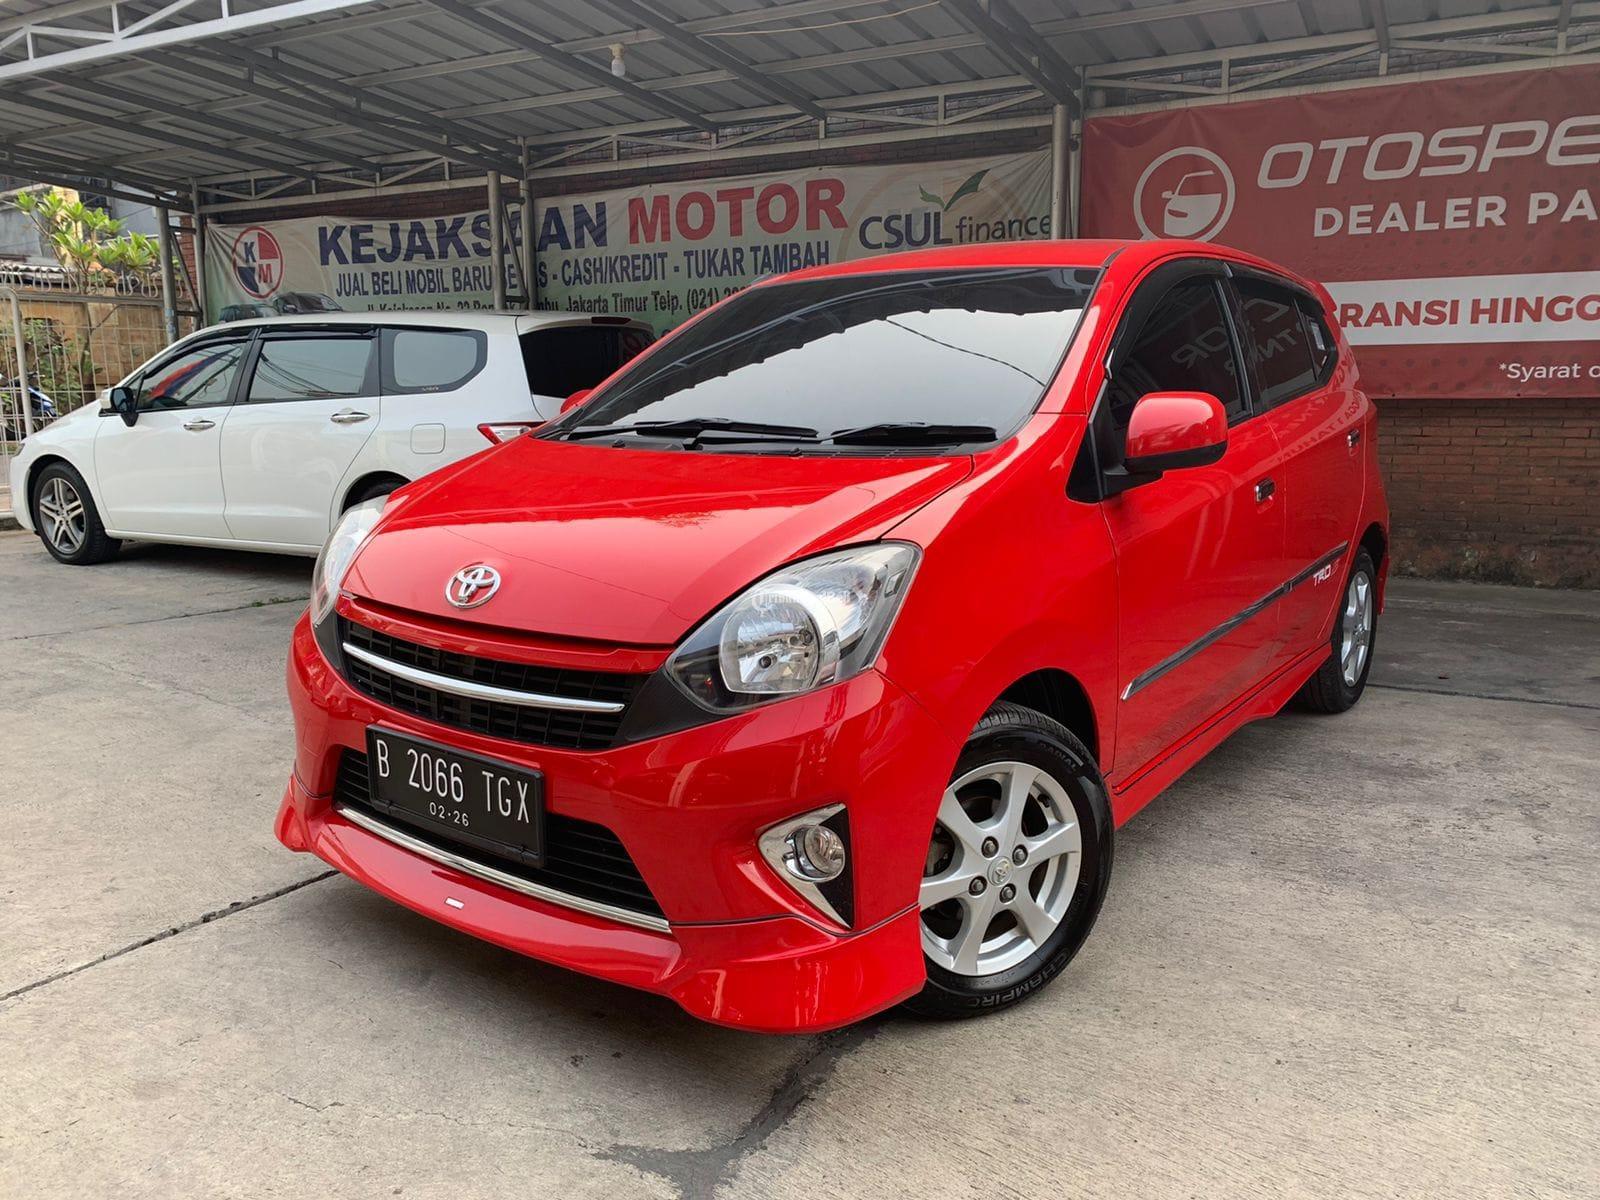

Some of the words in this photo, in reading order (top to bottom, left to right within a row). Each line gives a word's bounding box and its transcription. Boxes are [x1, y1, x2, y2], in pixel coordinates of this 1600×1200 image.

[1257, 114, 1600, 190] OTOSPE
[628, 178, 848, 244] MOTOR
[859, 212, 952, 249] CSUL
[955, 215, 1050, 243] finance
[1313, 195, 1506, 238] DEALER
[1528, 188, 1600, 225] PA
[244, 241, 257, 263] K
[561, 252, 668, 287] CASH/KREDIT
[683, 247, 745, 279] TUKAR
[750, 240, 829, 276] TAMBAH
[336, 271, 369, 297] JUAL
[371, 268, 402, 295] BELI
[405, 266, 450, 294] MOBIL
[452, 264, 492, 292] BARU
[566, 294, 608, 314] Jakarta
[612, 292, 648, 313] Timur
[651, 290, 682, 315] Telp.
[1339, 300, 1460, 328] RANSI
[1470, 293, 1600, 325] HINGG
[376, 739, 390, 778] B
[407, 748, 464, 802] 2066
[482, 770, 529, 824] TGX
